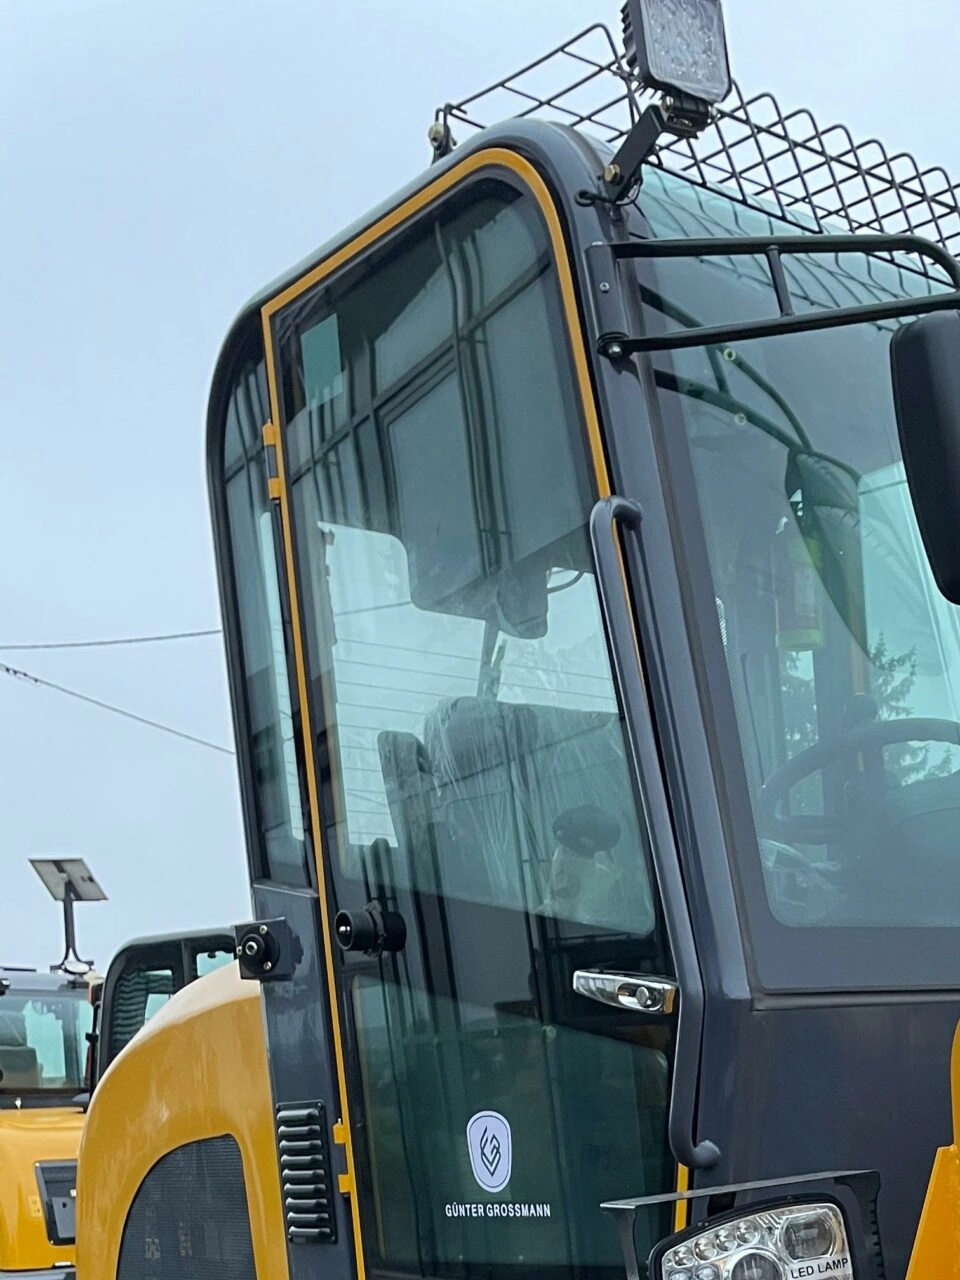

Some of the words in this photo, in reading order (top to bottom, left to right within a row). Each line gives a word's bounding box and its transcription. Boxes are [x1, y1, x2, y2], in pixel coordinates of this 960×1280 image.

[445, 1202, 485, 1217] GÜNTER
[486, 1203, 551, 1217] GROSSMANN
[791, 1265, 814, 1279] LED
[817, 1257, 848, 1273] LAMP
